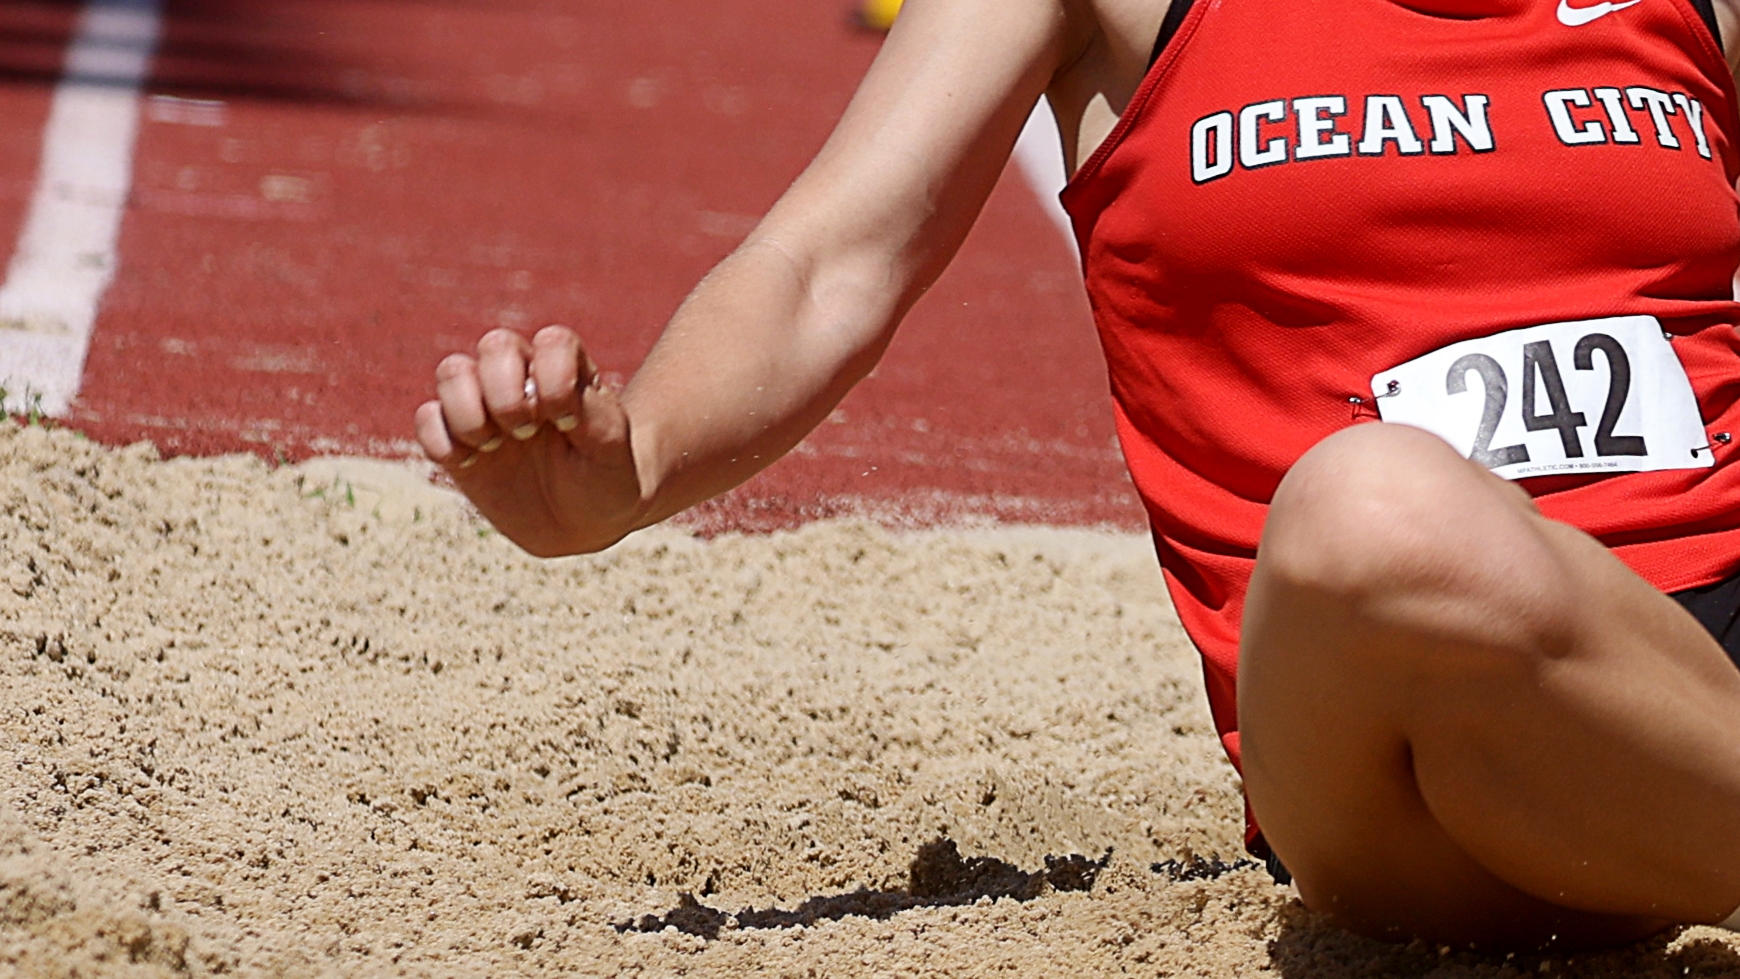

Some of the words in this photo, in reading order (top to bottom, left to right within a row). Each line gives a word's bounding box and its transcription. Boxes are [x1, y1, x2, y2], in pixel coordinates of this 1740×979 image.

[1191, 93, 1496, 185] OCEAN
[1543, 86, 1712, 160] CITY
[1445, 332, 1649, 470] 242
